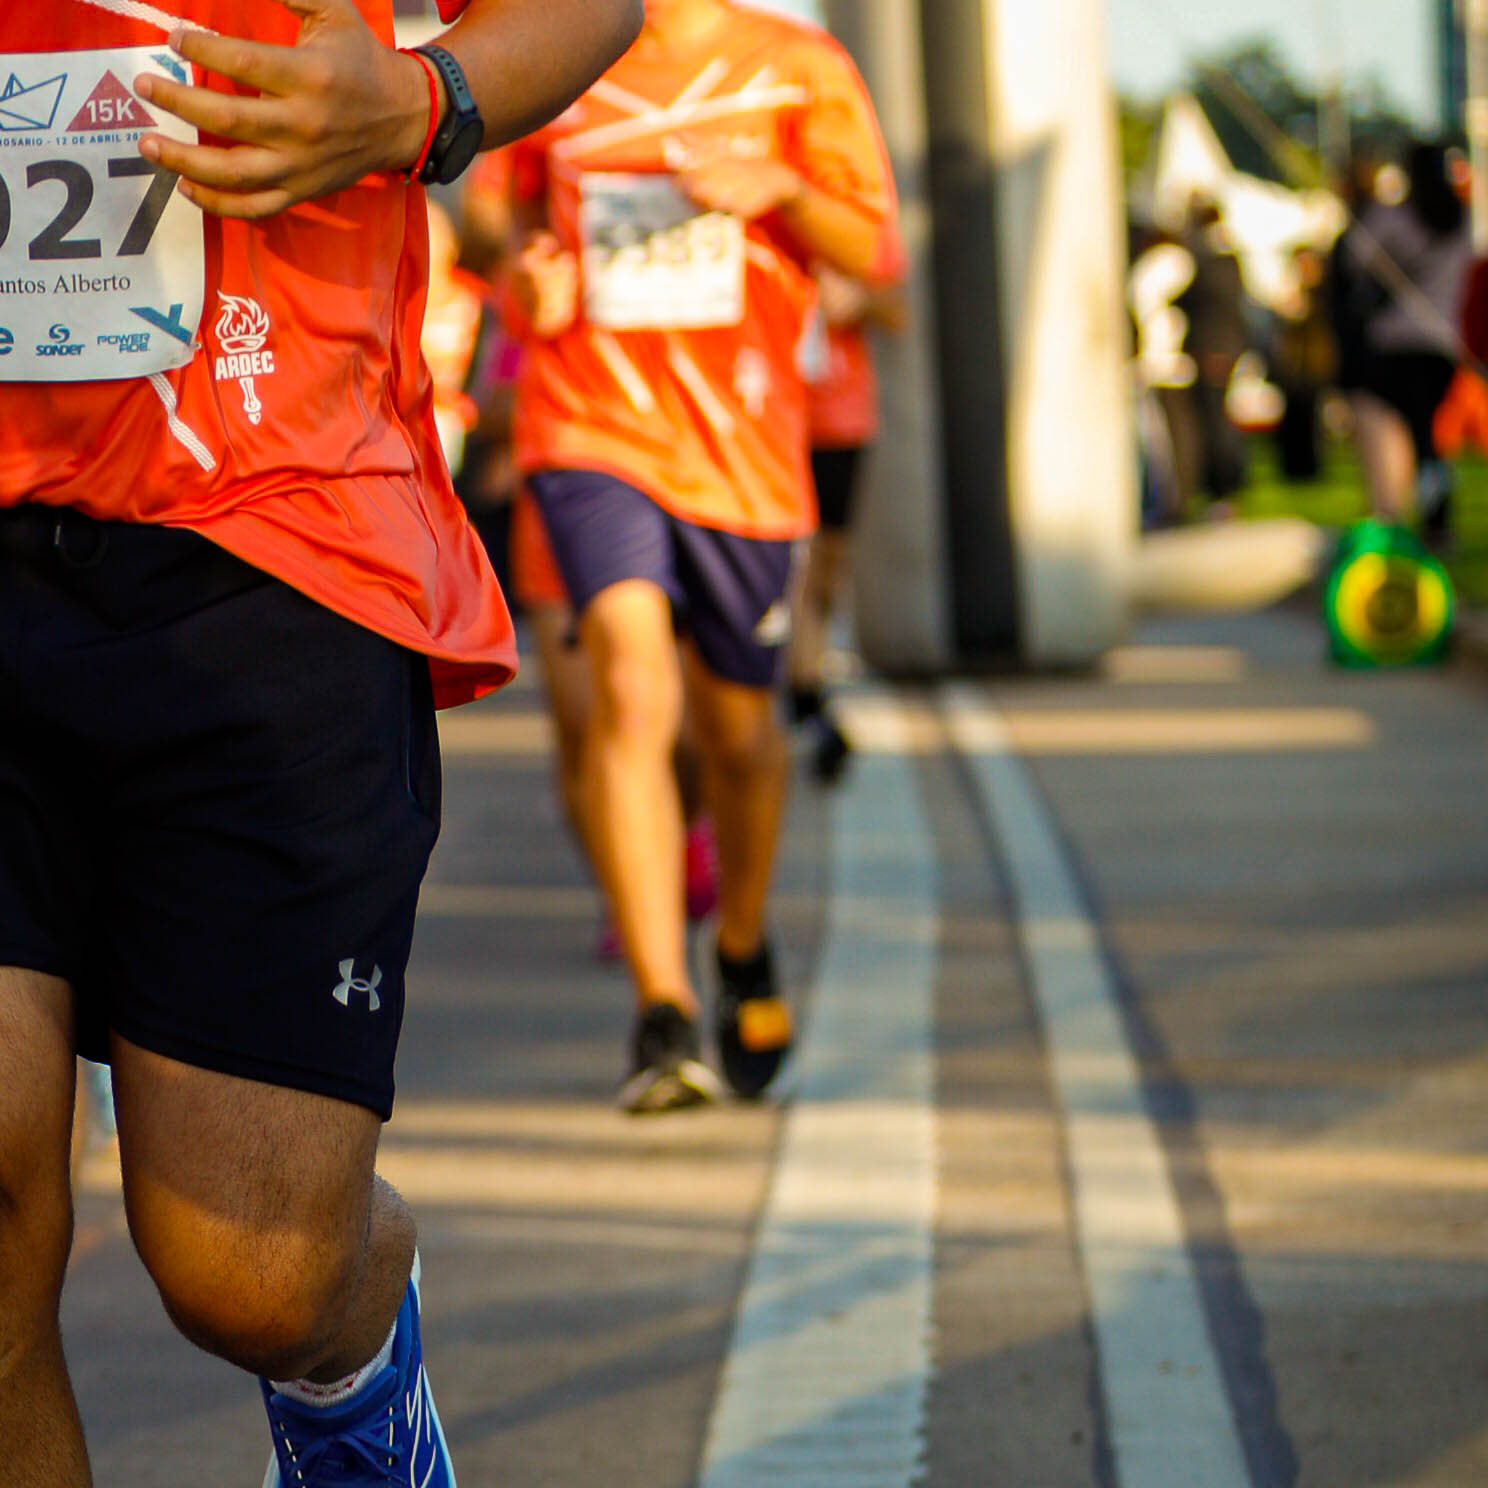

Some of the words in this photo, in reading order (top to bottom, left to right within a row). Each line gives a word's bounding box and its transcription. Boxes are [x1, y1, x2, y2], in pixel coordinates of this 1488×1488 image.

[86, 97, 135, 124] 15K
[56, 137, 67, 145] 12
[72, 136, 85, 145] DE
[90, 134, 122, 144] ABRIL
[53, 275, 131, 293] Alberto
[97, 332, 151, 346] POWER
[215, 350, 275, 381] ARDEC
